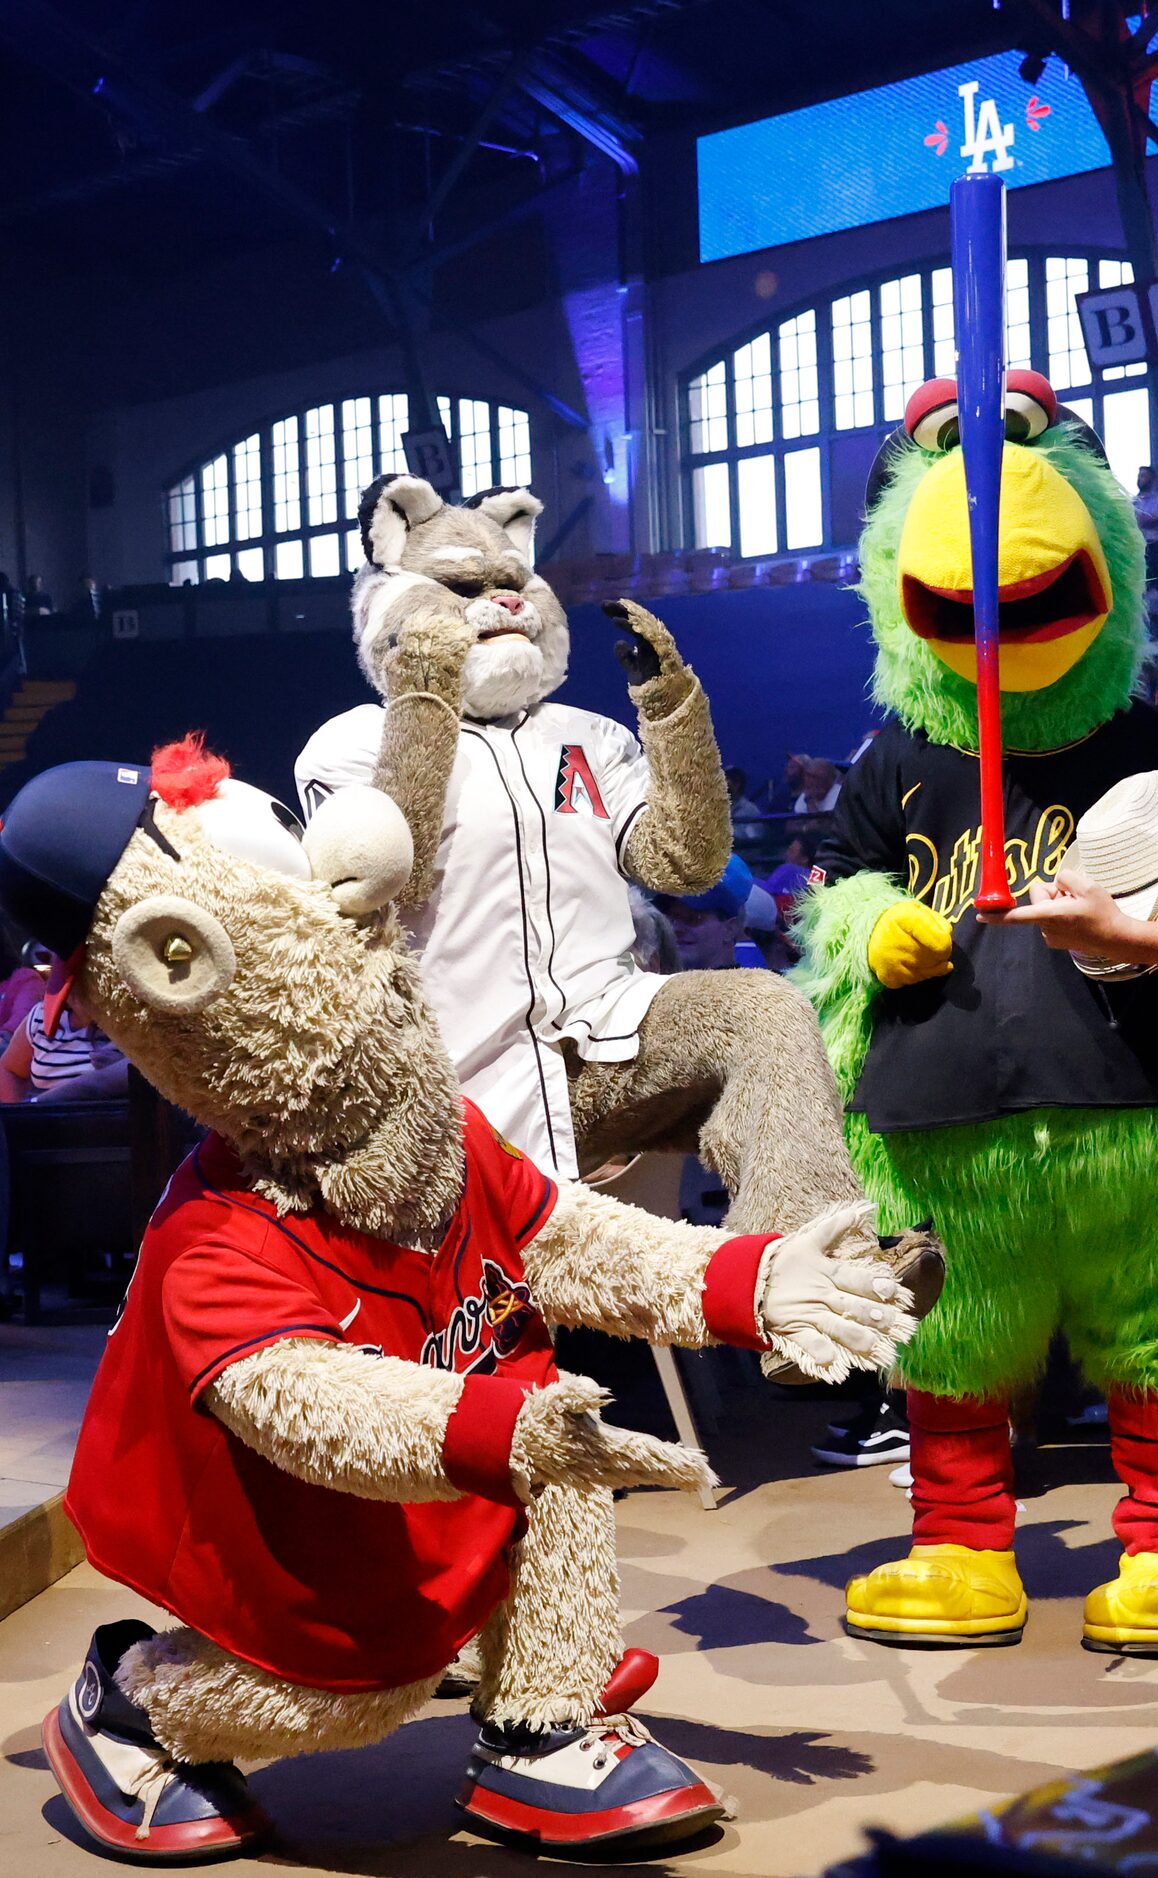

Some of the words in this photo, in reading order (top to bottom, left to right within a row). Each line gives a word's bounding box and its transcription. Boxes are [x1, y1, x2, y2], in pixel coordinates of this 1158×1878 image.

[957, 80, 1015, 173] LA
[1090, 305, 1136, 349] B
[553, 744, 611, 819] A
